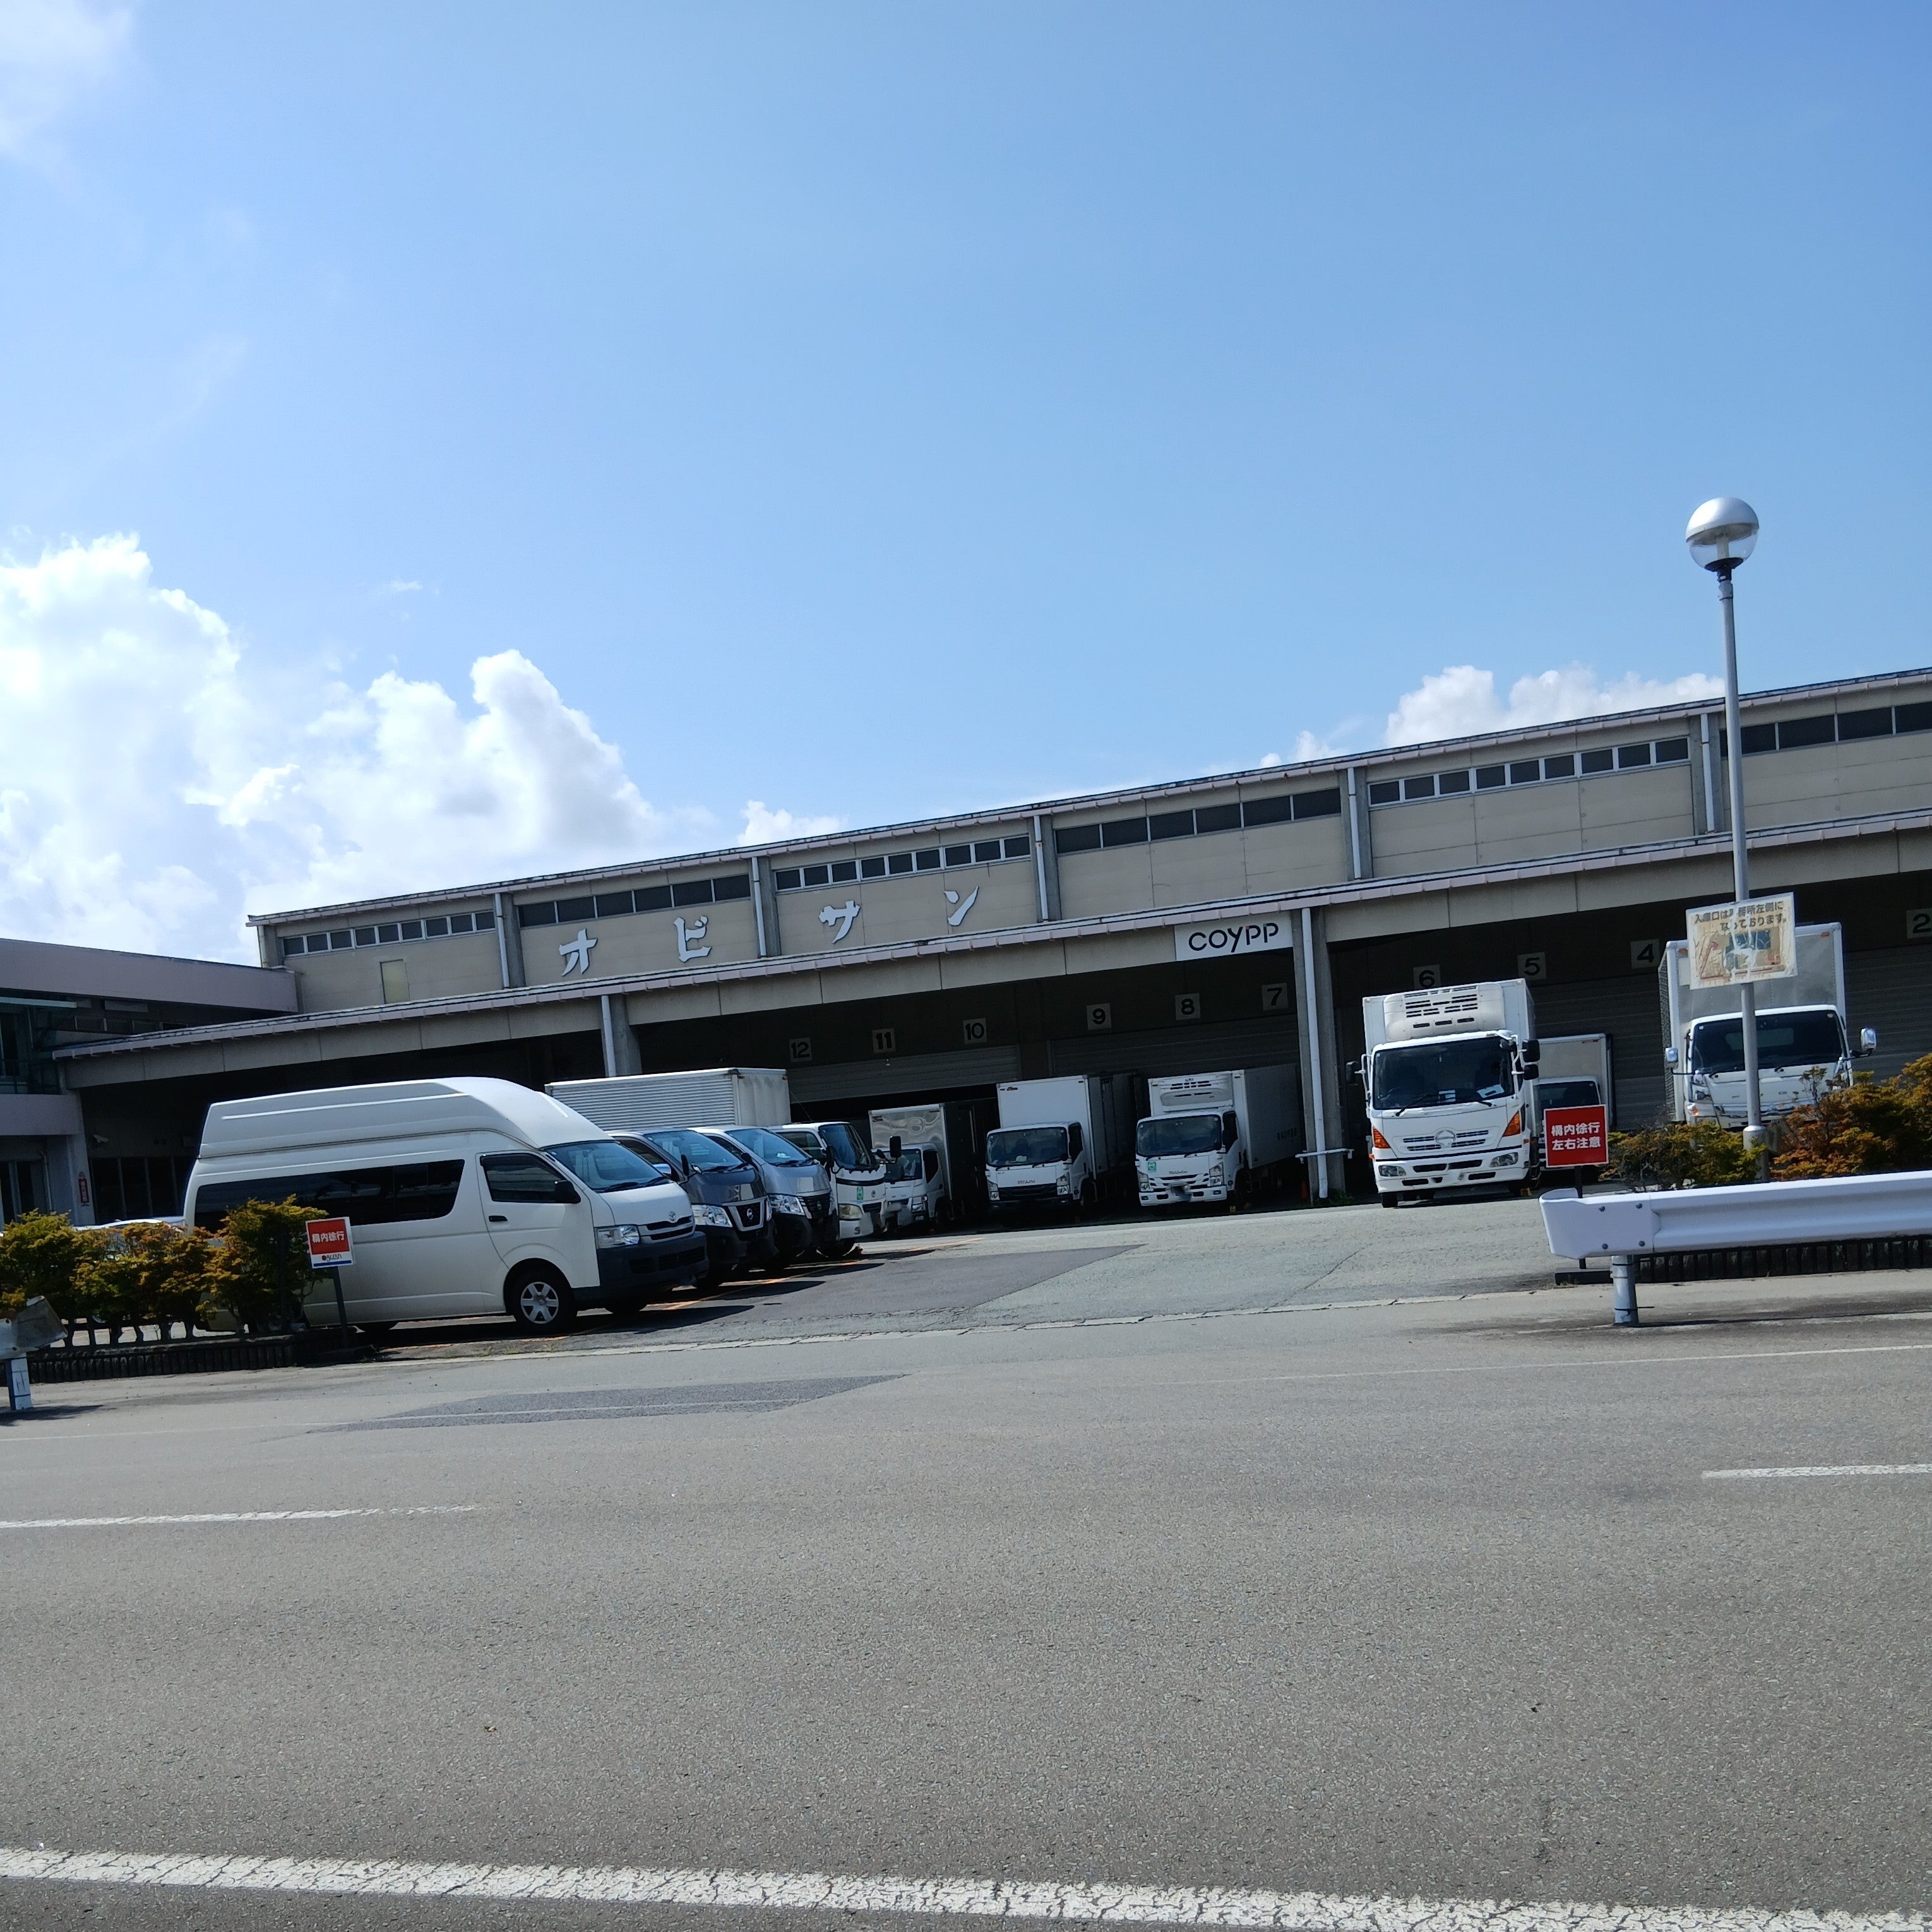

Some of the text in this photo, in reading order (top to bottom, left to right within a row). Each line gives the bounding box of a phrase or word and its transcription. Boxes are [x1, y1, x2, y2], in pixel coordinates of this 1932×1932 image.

[559, 885, 979, 977] オビサン
[1912, 913, 1931, 934] 2
[1636, 943, 1653, 963] 4
[1524, 957, 1541, 976] 5
[1419, 970, 1435, 989] 6
[1267, 987, 1283, 1006] 7
[1181, 998, 1195, 1015] 8
[1092, 1008, 1106, 1025] 9
[876, 1031, 893, 1049] 11
[965, 1022, 985, 1041] 10
[790, 1041, 811, 1059] 12
[1551, 1121, 1601, 1137] 構内徐行
[1551, 1136, 1601, 1151] 左右注意
